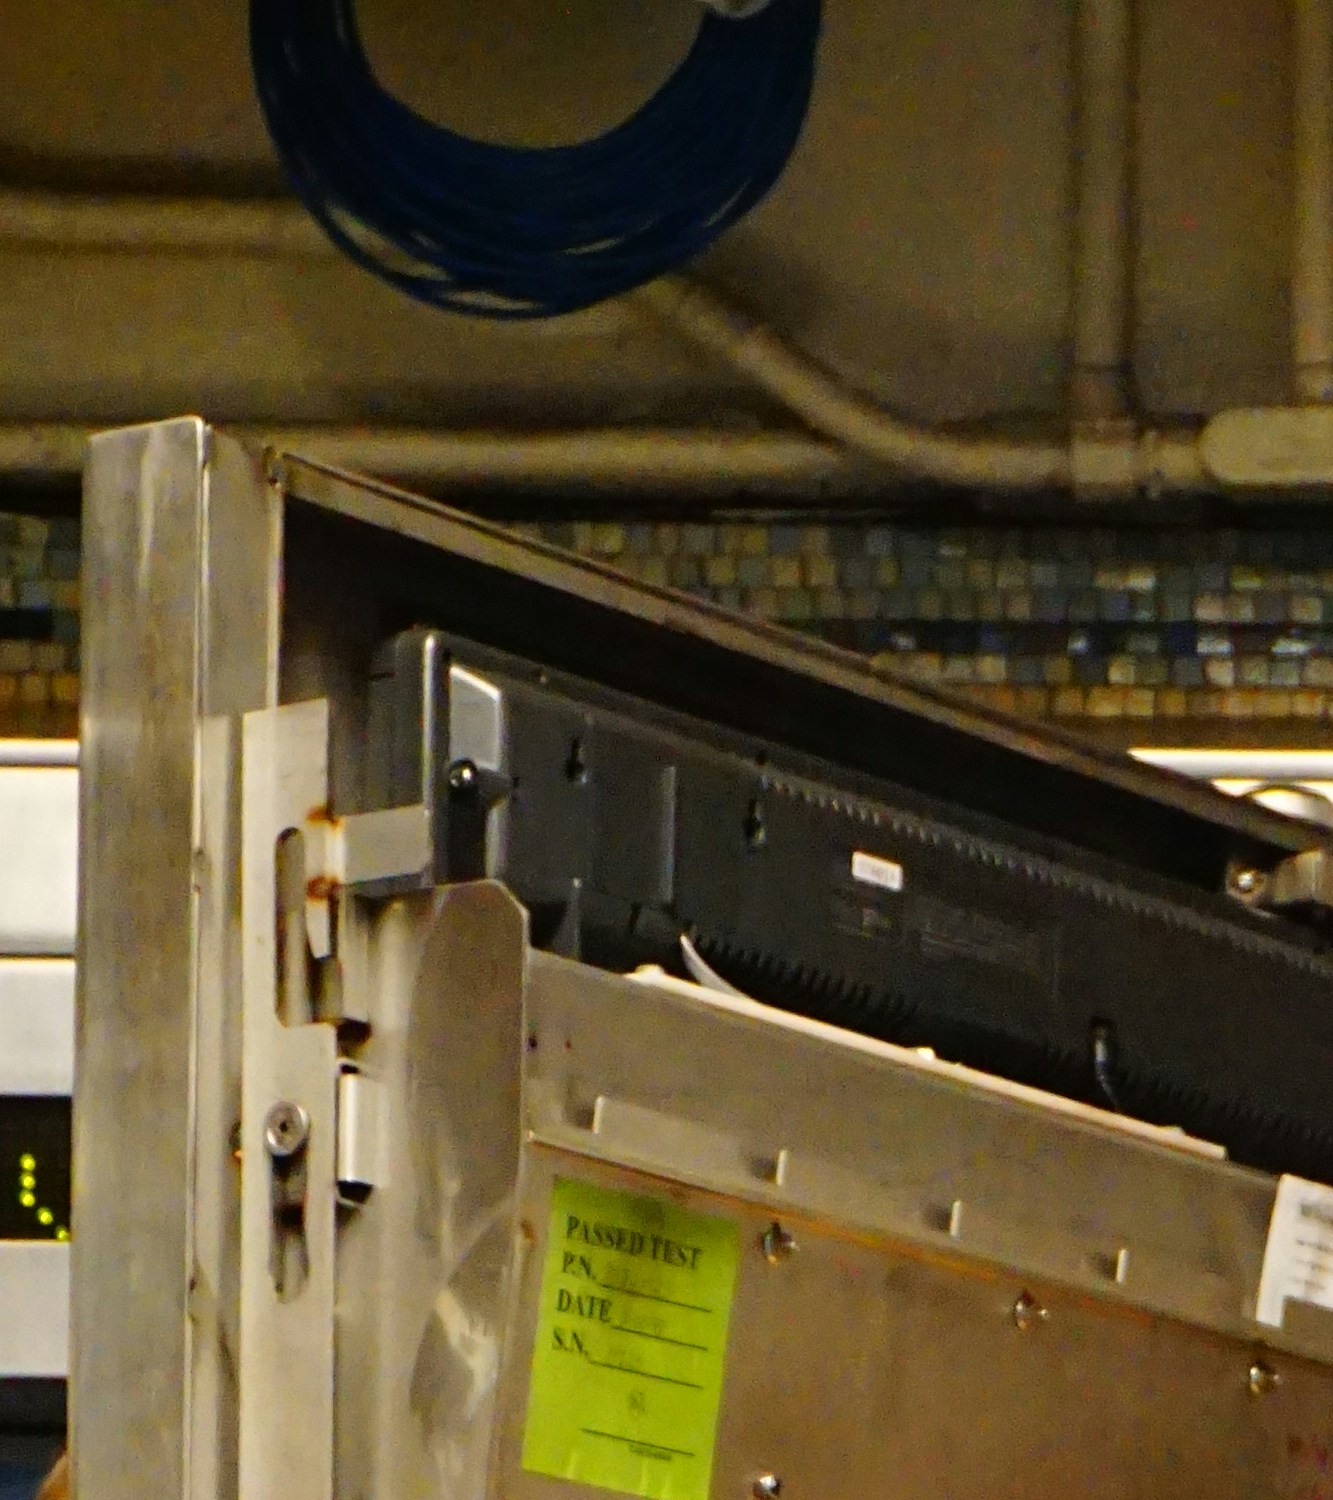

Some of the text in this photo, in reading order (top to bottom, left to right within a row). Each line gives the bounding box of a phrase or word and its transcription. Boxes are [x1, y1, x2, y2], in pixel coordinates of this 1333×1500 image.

[566, 1215, 702, 1270] PASSED TEST
[557, 1288, 613, 1323] DATE
